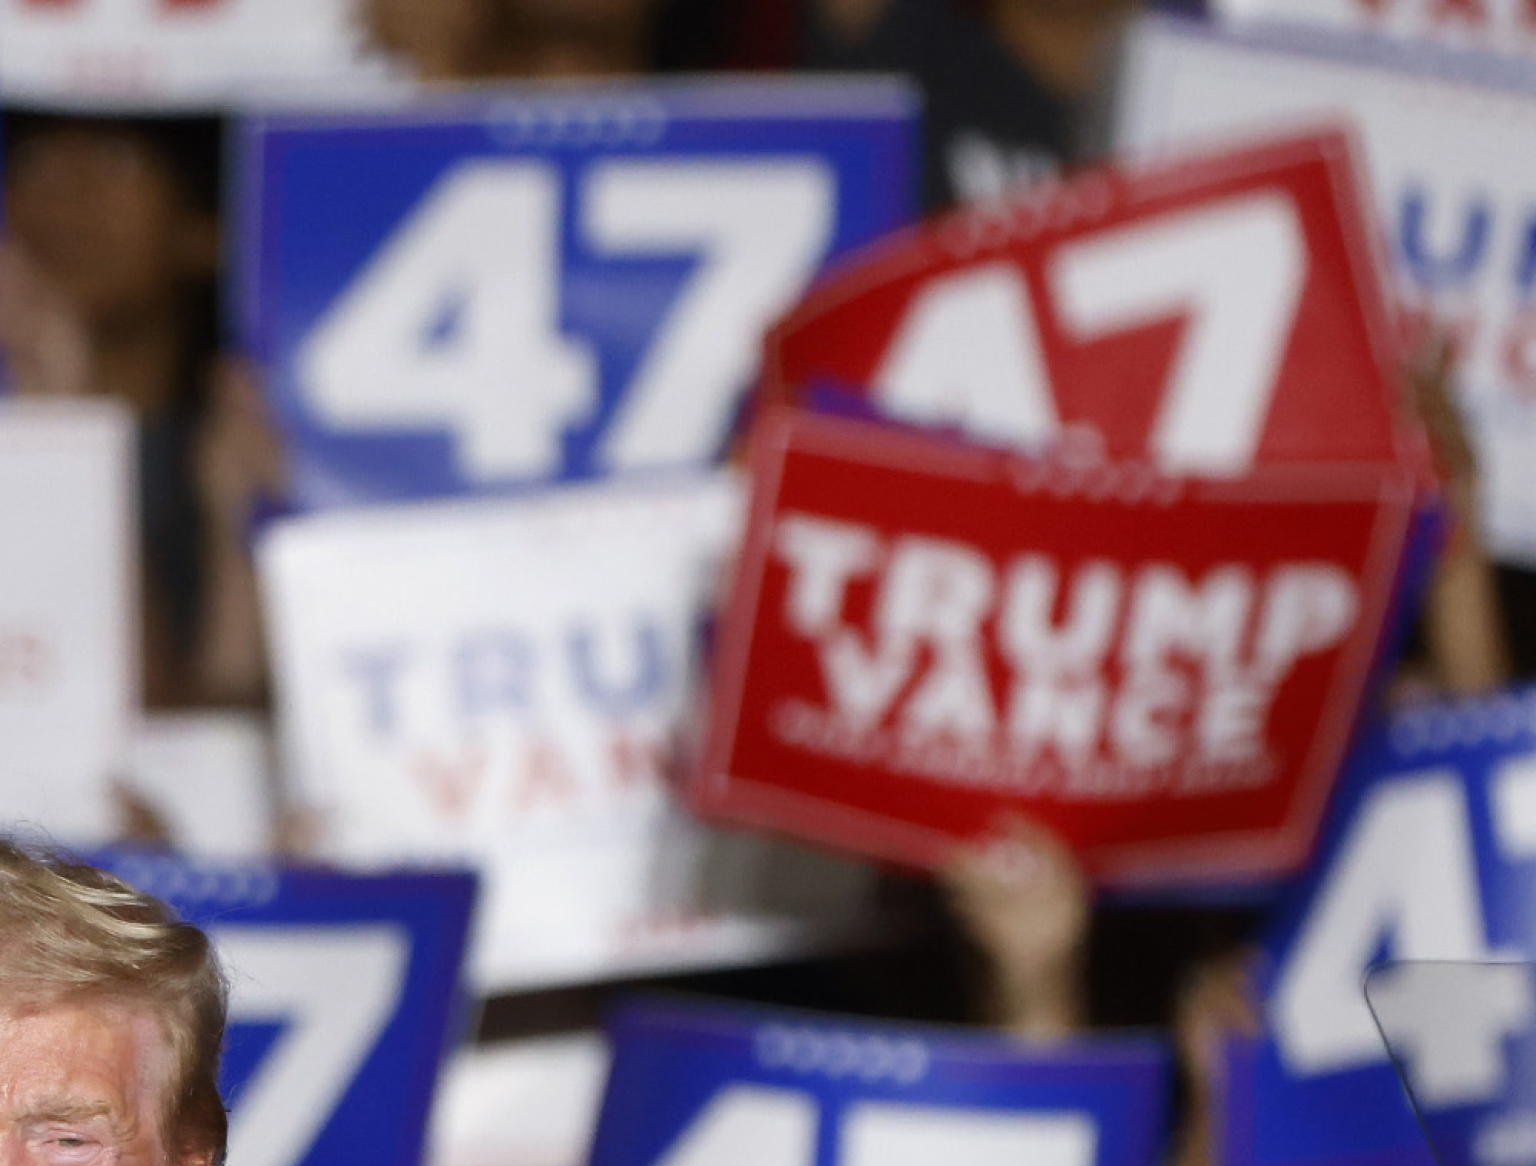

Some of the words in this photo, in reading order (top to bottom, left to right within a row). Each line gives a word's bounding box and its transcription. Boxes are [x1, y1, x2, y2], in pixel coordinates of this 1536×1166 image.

[292, 160, 834, 482] 47
[776, 515, 1356, 688] TRUMP
[820, 630, 1270, 768] VANCE
